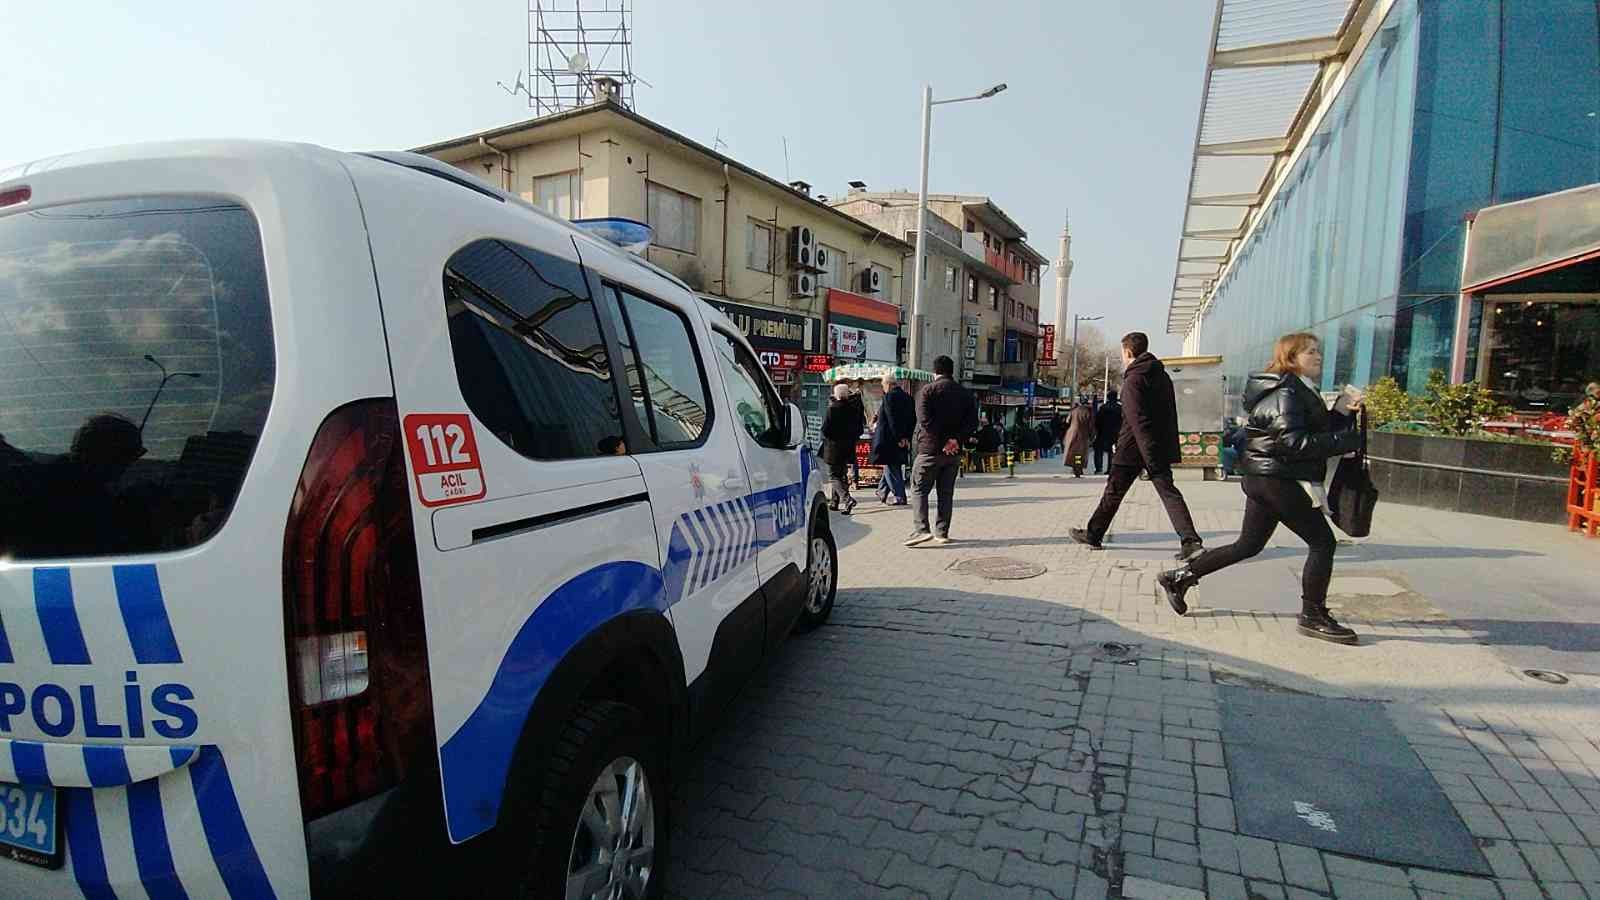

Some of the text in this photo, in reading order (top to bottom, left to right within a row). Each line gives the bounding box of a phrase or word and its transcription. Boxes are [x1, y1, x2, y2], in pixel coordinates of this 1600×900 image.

[760, 352, 781, 366] CTD
[1045, 326, 1054, 359] OTEL
[416, 424, 471, 466] 112
[771, 491, 800, 534] POLİS
[0, 671, 198, 738] POLİS
